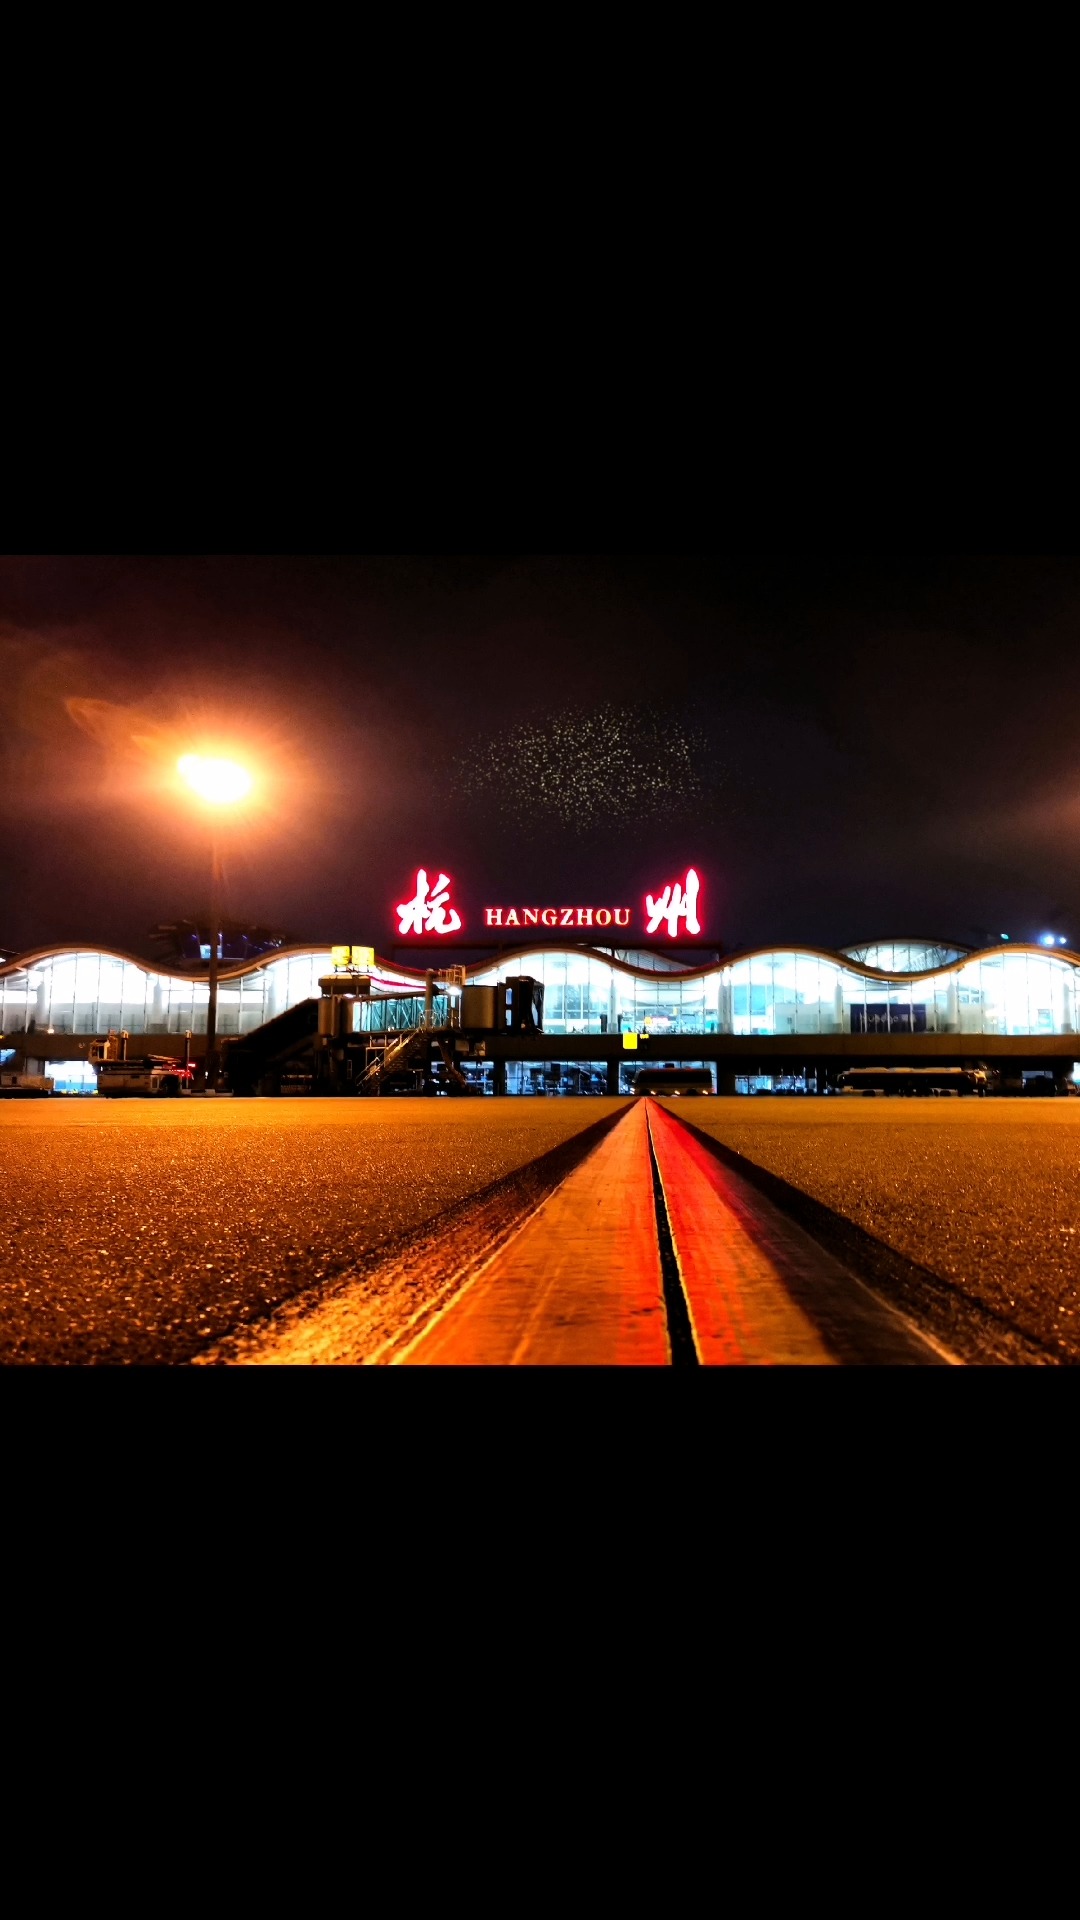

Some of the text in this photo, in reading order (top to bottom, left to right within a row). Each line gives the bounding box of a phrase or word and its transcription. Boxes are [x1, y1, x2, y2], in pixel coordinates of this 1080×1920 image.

[397, 869, 461, 934] 杭
[486, 908, 630, 926] HANGZHOU
[646, 869, 700, 937] 州
